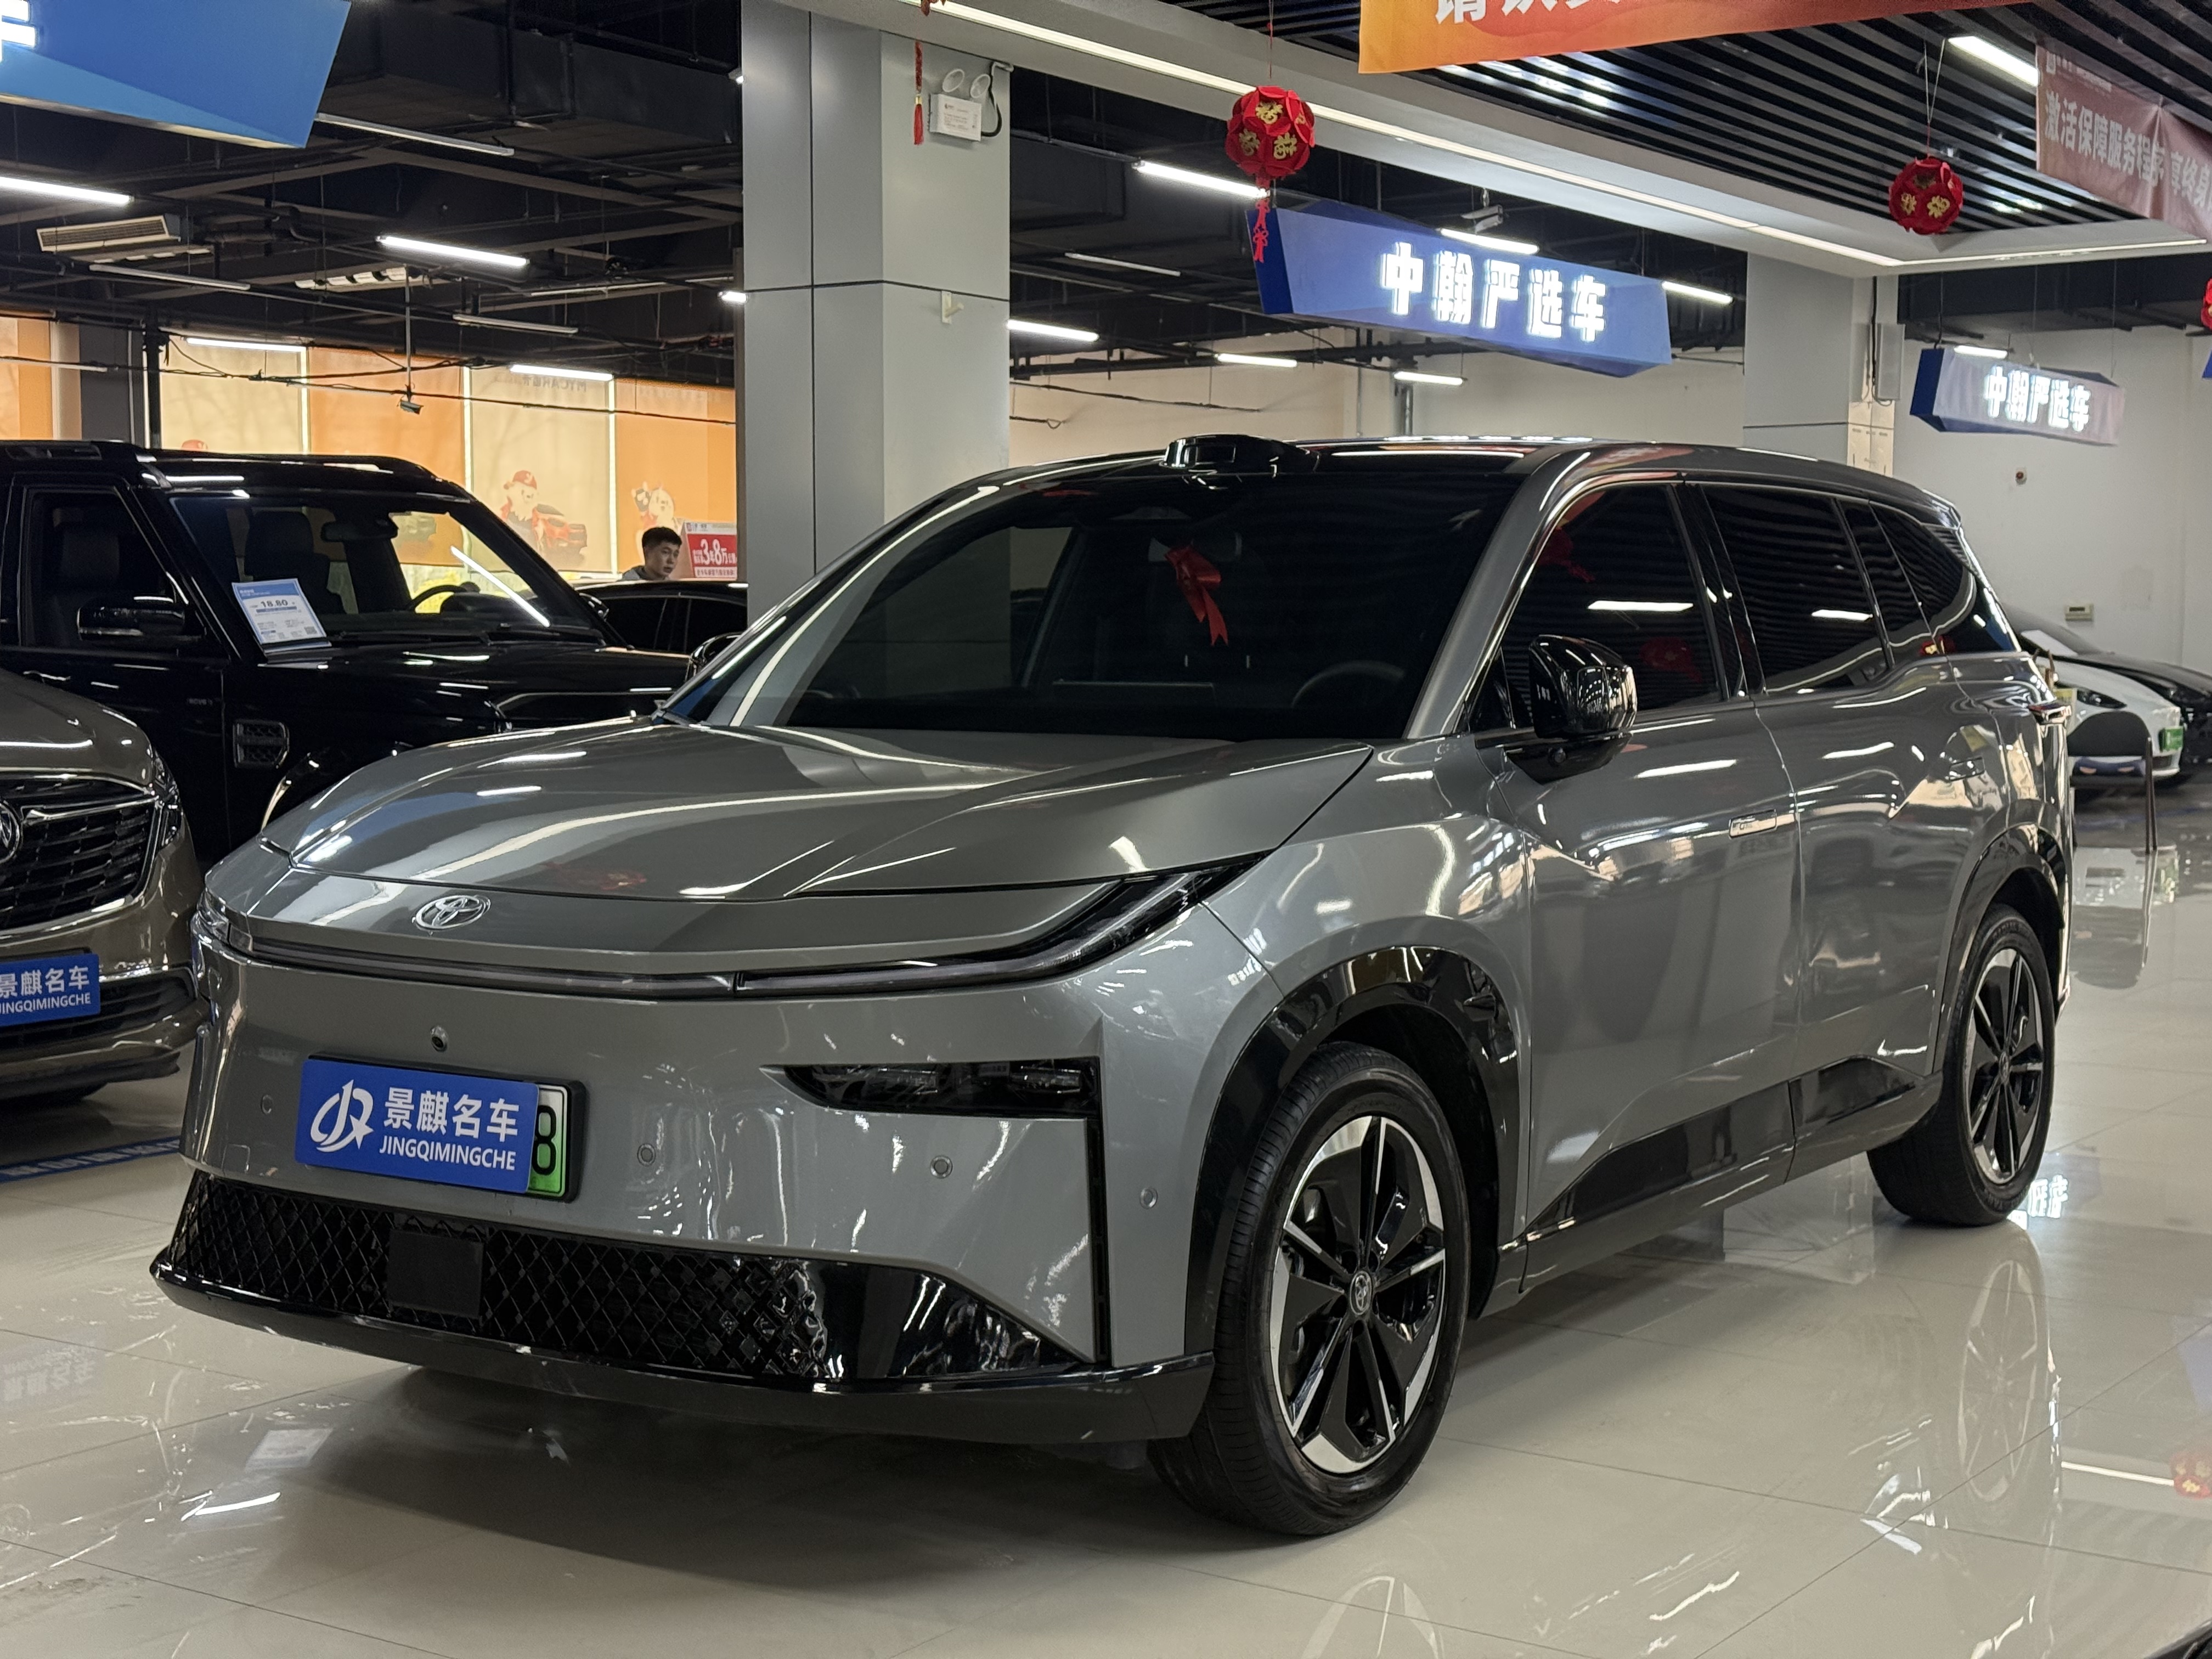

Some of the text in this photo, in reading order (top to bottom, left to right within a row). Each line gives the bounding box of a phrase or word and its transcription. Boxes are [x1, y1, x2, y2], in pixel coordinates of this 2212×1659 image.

[2171, 151, 2212, 211] 享终身
[1380, 241, 1606, 342] 中翰严选车
[1984, 365, 2091, 432] 中翰严选车
[261, 599, 288, 608] 18.80
[0, 965, 89, 998] 景麒名车
[0, 992, 91, 1014] INGQIMINGCHE
[383, 1087, 520, 1142] 景麒名车
[380, 1135, 517, 1171] JINGQIMINGCHE
